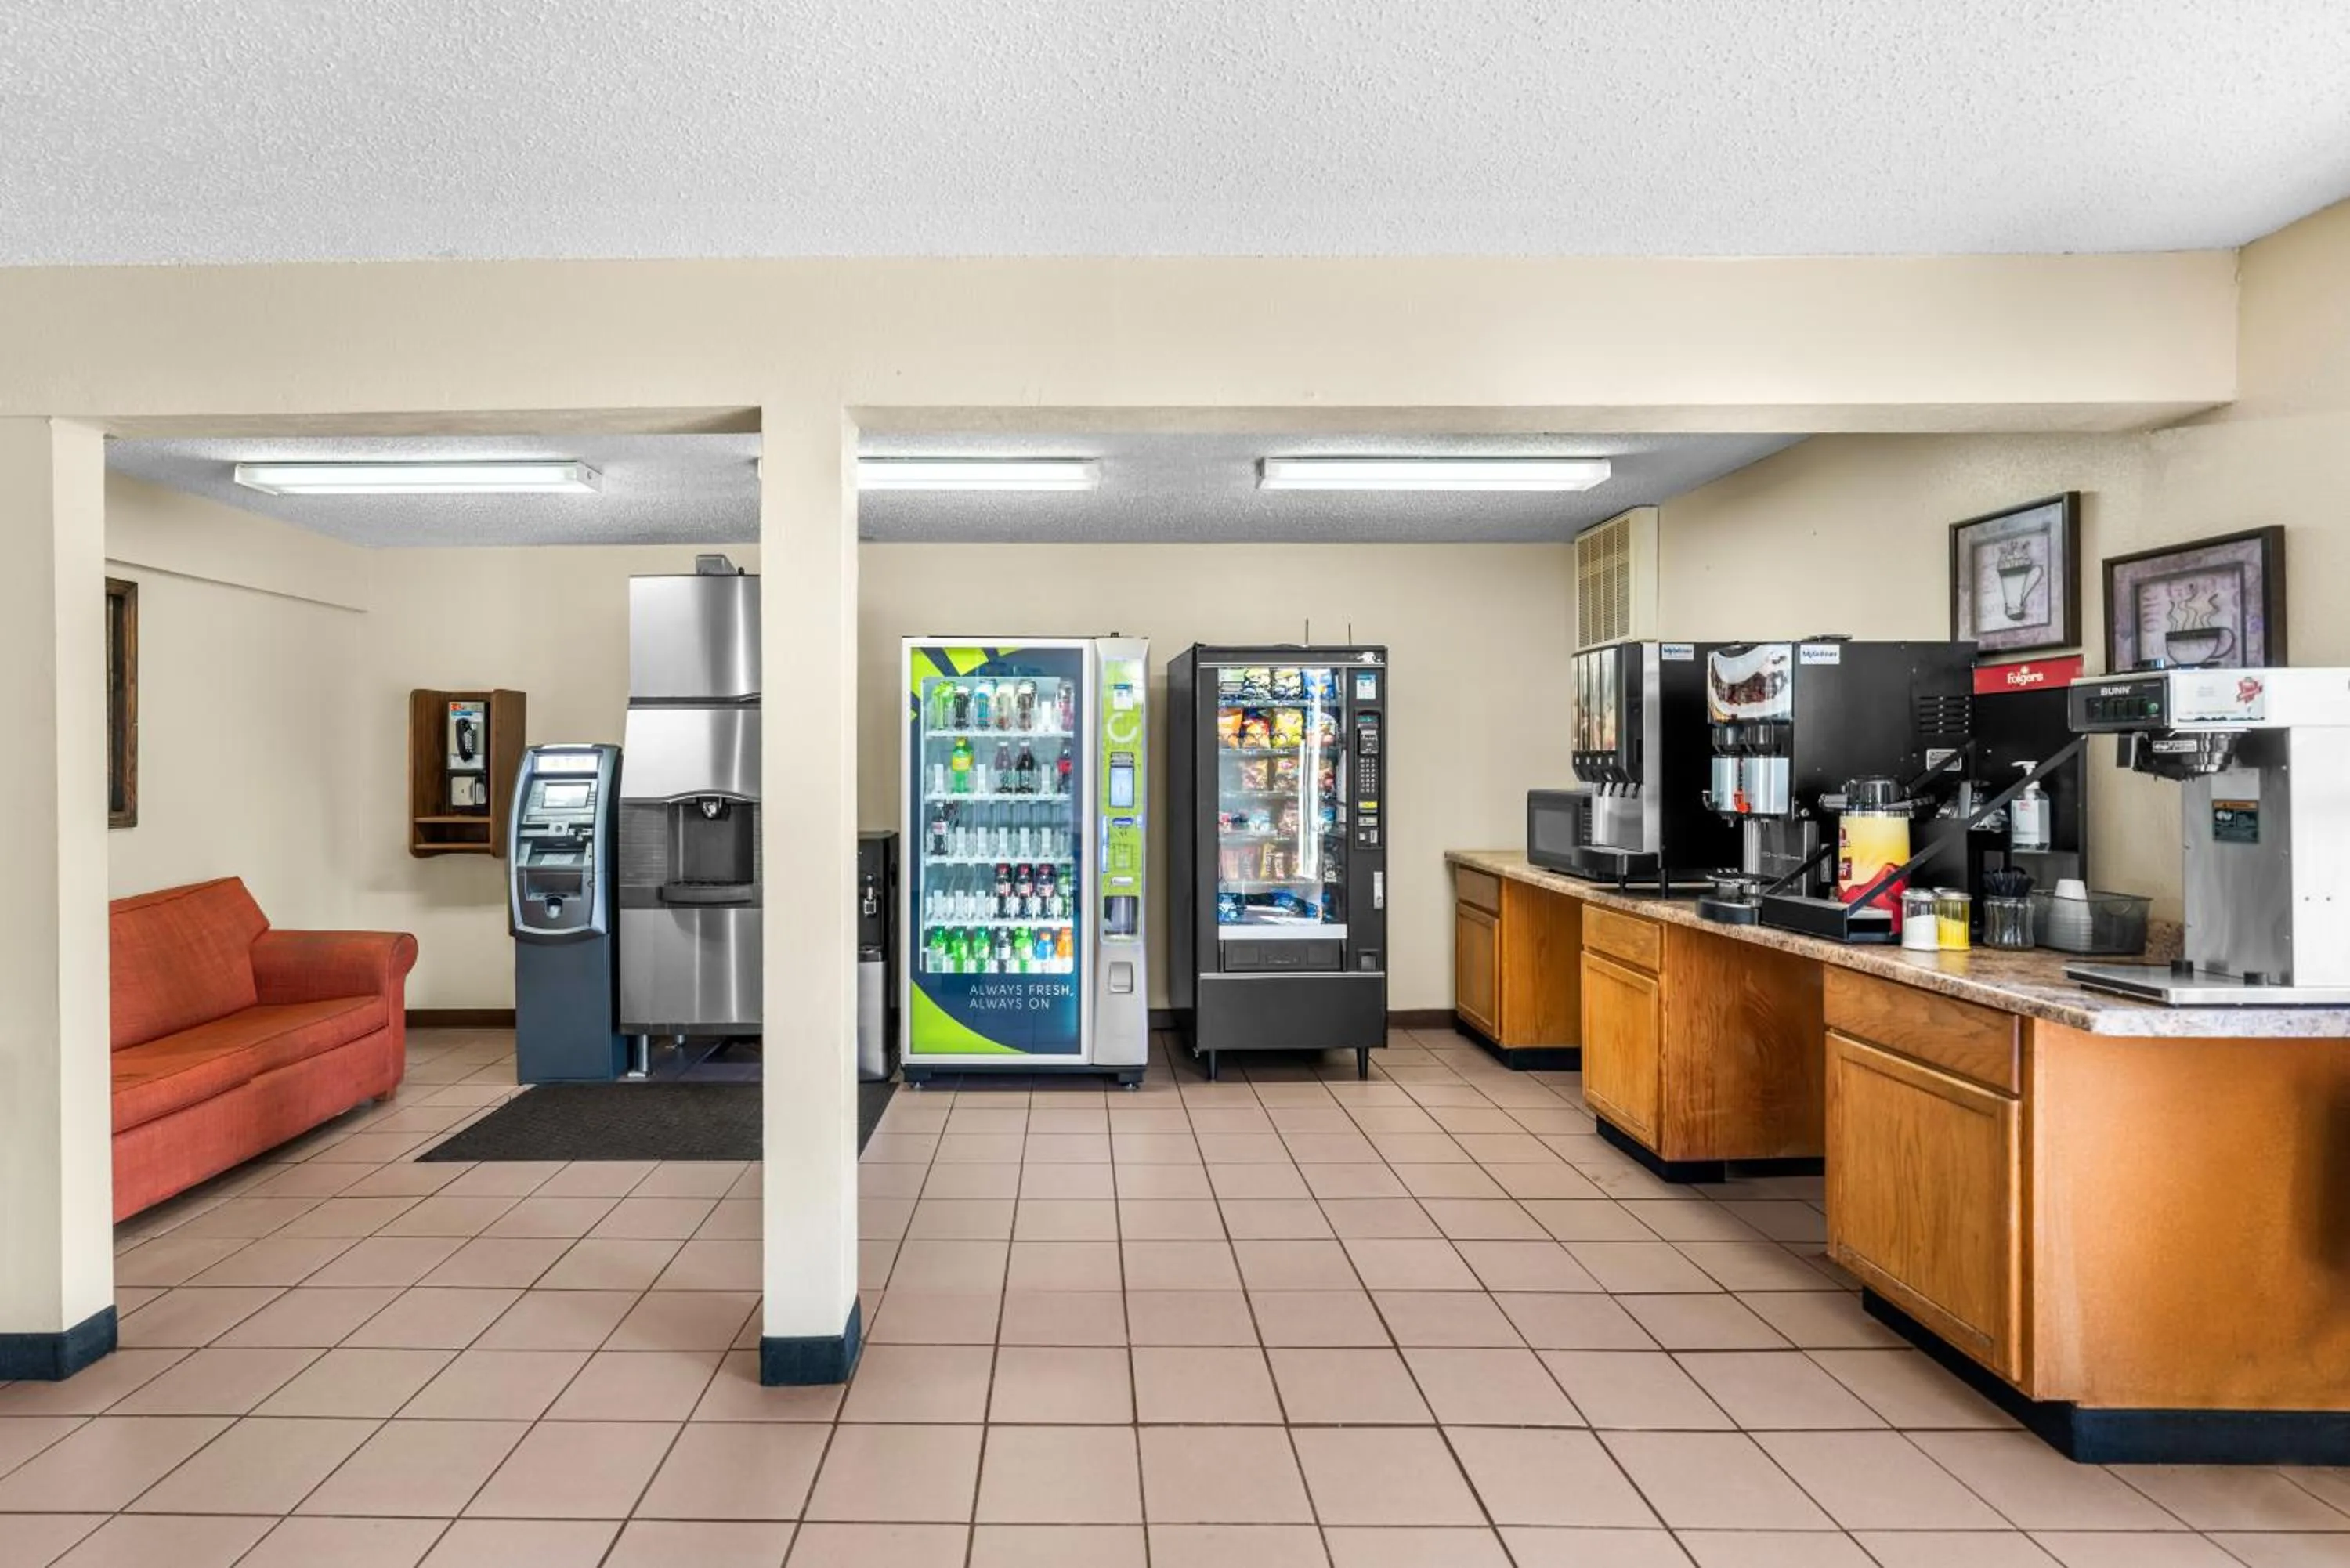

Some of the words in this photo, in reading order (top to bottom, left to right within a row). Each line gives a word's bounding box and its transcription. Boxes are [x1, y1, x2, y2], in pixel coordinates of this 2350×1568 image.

[2007, 671, 2044, 686] Folgers
[2100, 686, 2131, 696] BUNN
[969, 984, 1022, 995] ALWAYS
[1029, 984, 1074, 997] FRESH,
[969, 997, 1022, 1010] ALWAYS
[1029, 997, 1050, 1010] ON
